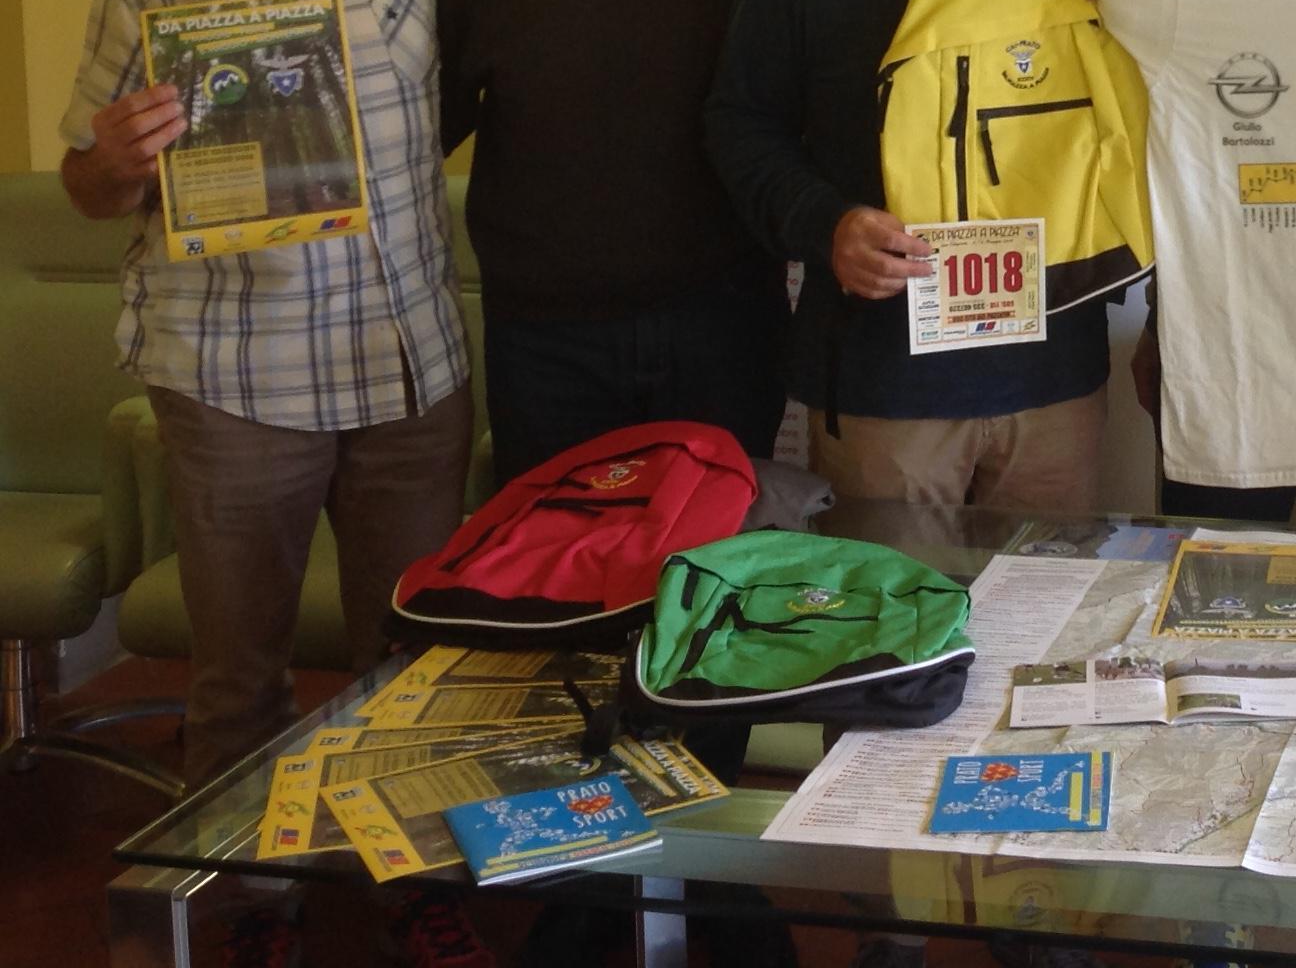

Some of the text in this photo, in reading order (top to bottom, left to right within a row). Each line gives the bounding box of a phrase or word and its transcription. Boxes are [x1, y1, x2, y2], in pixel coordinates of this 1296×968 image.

[158, 4, 325, 34] DA PIAZZA A PIAZZA
[1222, 136, 1275, 147] Bartolozzi
[943, 250, 1024, 298] 1018
[556, 781, 611, 803] PRATO
[572, 805, 627, 829] SPORT
